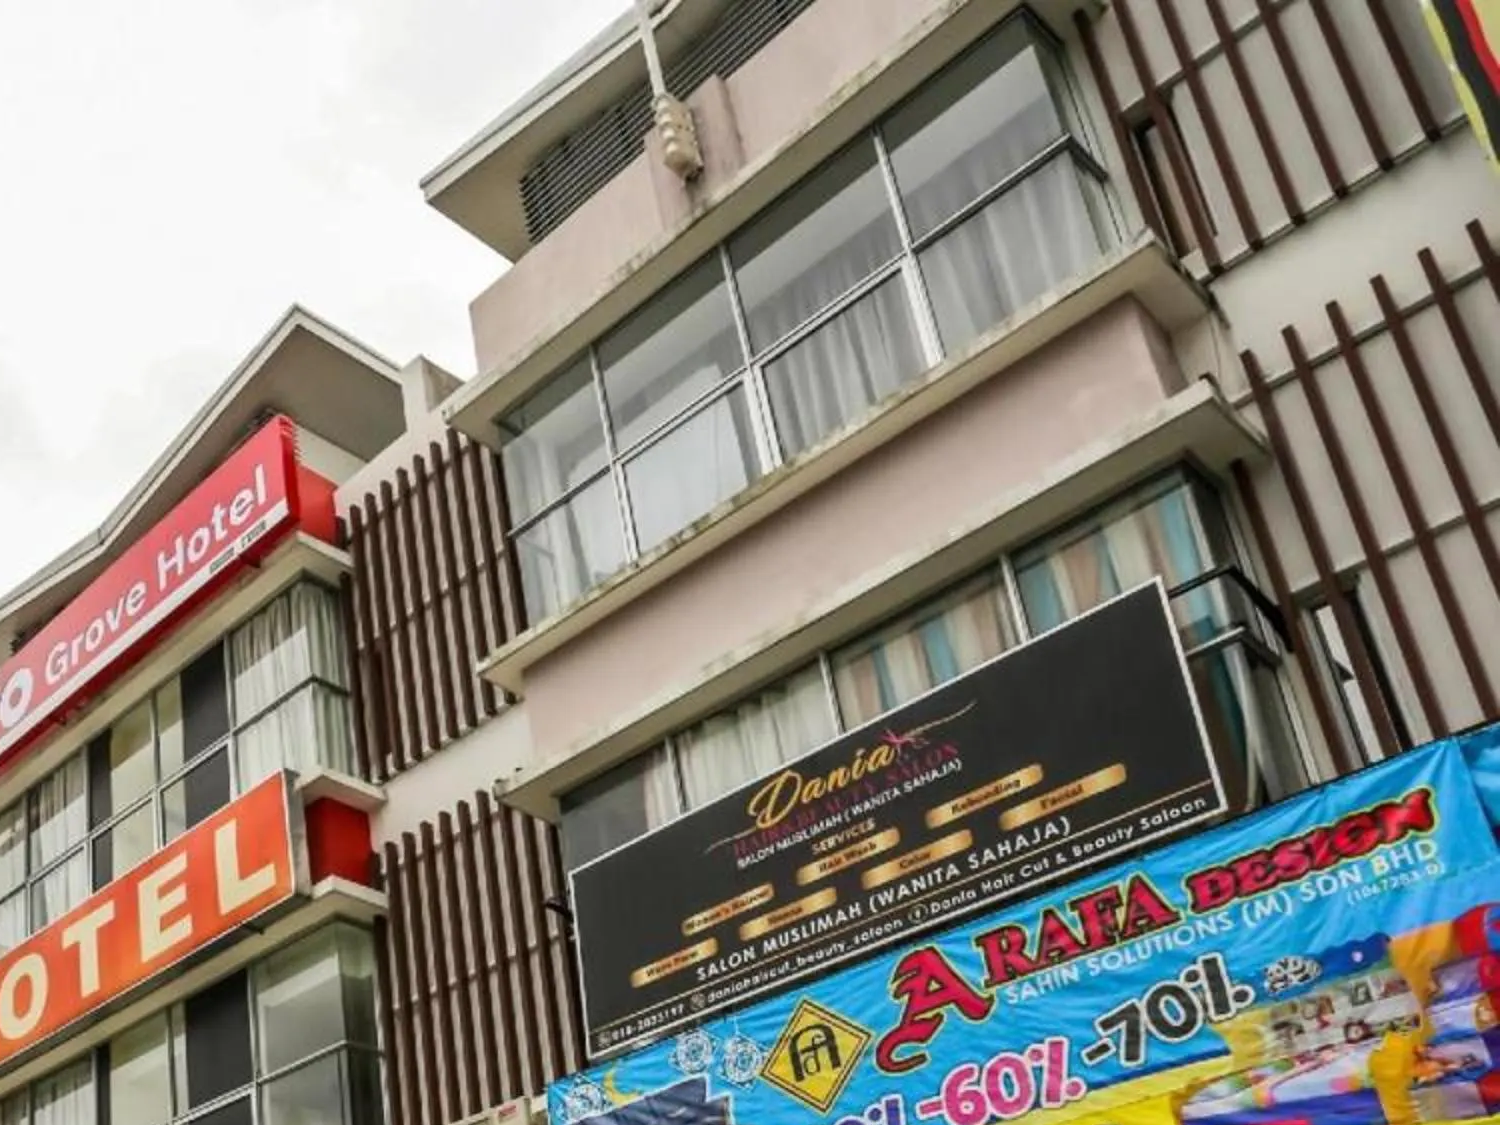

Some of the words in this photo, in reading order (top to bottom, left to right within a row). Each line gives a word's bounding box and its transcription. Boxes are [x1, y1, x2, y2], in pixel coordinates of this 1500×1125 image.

[45, 580, 147, 685] Grove
[156, 463, 268, 592] Hotel
[748, 741, 896, 829] Dania
[810, 815, 877, 857] SERVICES
[695, 943, 757, 983] SALON
[761, 900, 862, 956] MUSLIMAH
[867, 858, 962, 914] (WANITA
[967, 814, 1073, 872] SAHAJA)
[930, 888, 976, 914] Dania
[981, 870, 1015, 895] Hair
[1019, 857, 1050, 878] Cut
[1054, 850, 1067, 865] &
[1073, 824, 1134, 857] Beauty
[1138, 797, 1207, 831] Saloon
[1185, 787, 1435, 913] DESIGN
[1004, 962, 1080, 1005] SAHIN
[1087, 911, 1235, 976] SOLUTIONS
[1241, 892, 1293, 930] (M)
[1301, 863, 1363, 903] SDN
[1371, 839, 1438, 877] BHD
[1083, 953, 1254, 1065] -70%
